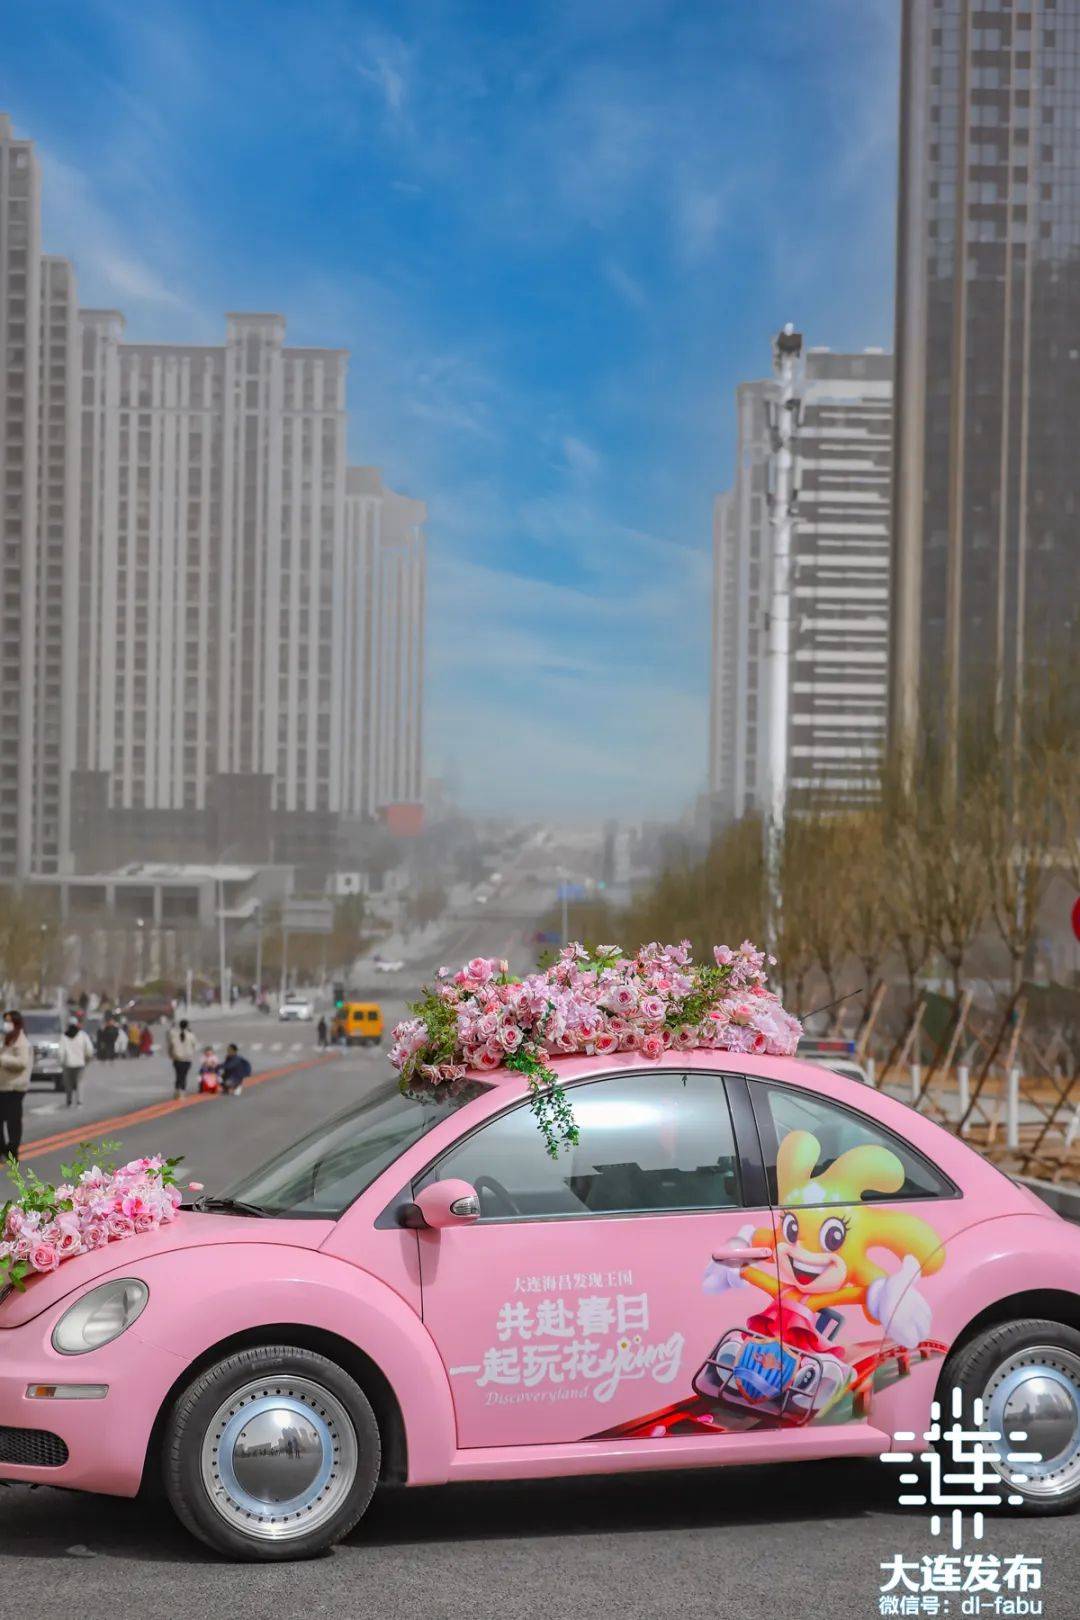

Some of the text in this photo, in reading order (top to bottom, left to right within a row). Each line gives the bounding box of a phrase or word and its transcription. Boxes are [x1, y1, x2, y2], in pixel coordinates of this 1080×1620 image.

[513, 1269, 632, 1293] 大连海昌发现王国
[496, 1292, 649, 1341] 共赴春日
[485, 1384, 590, 1407] Discoveryland
